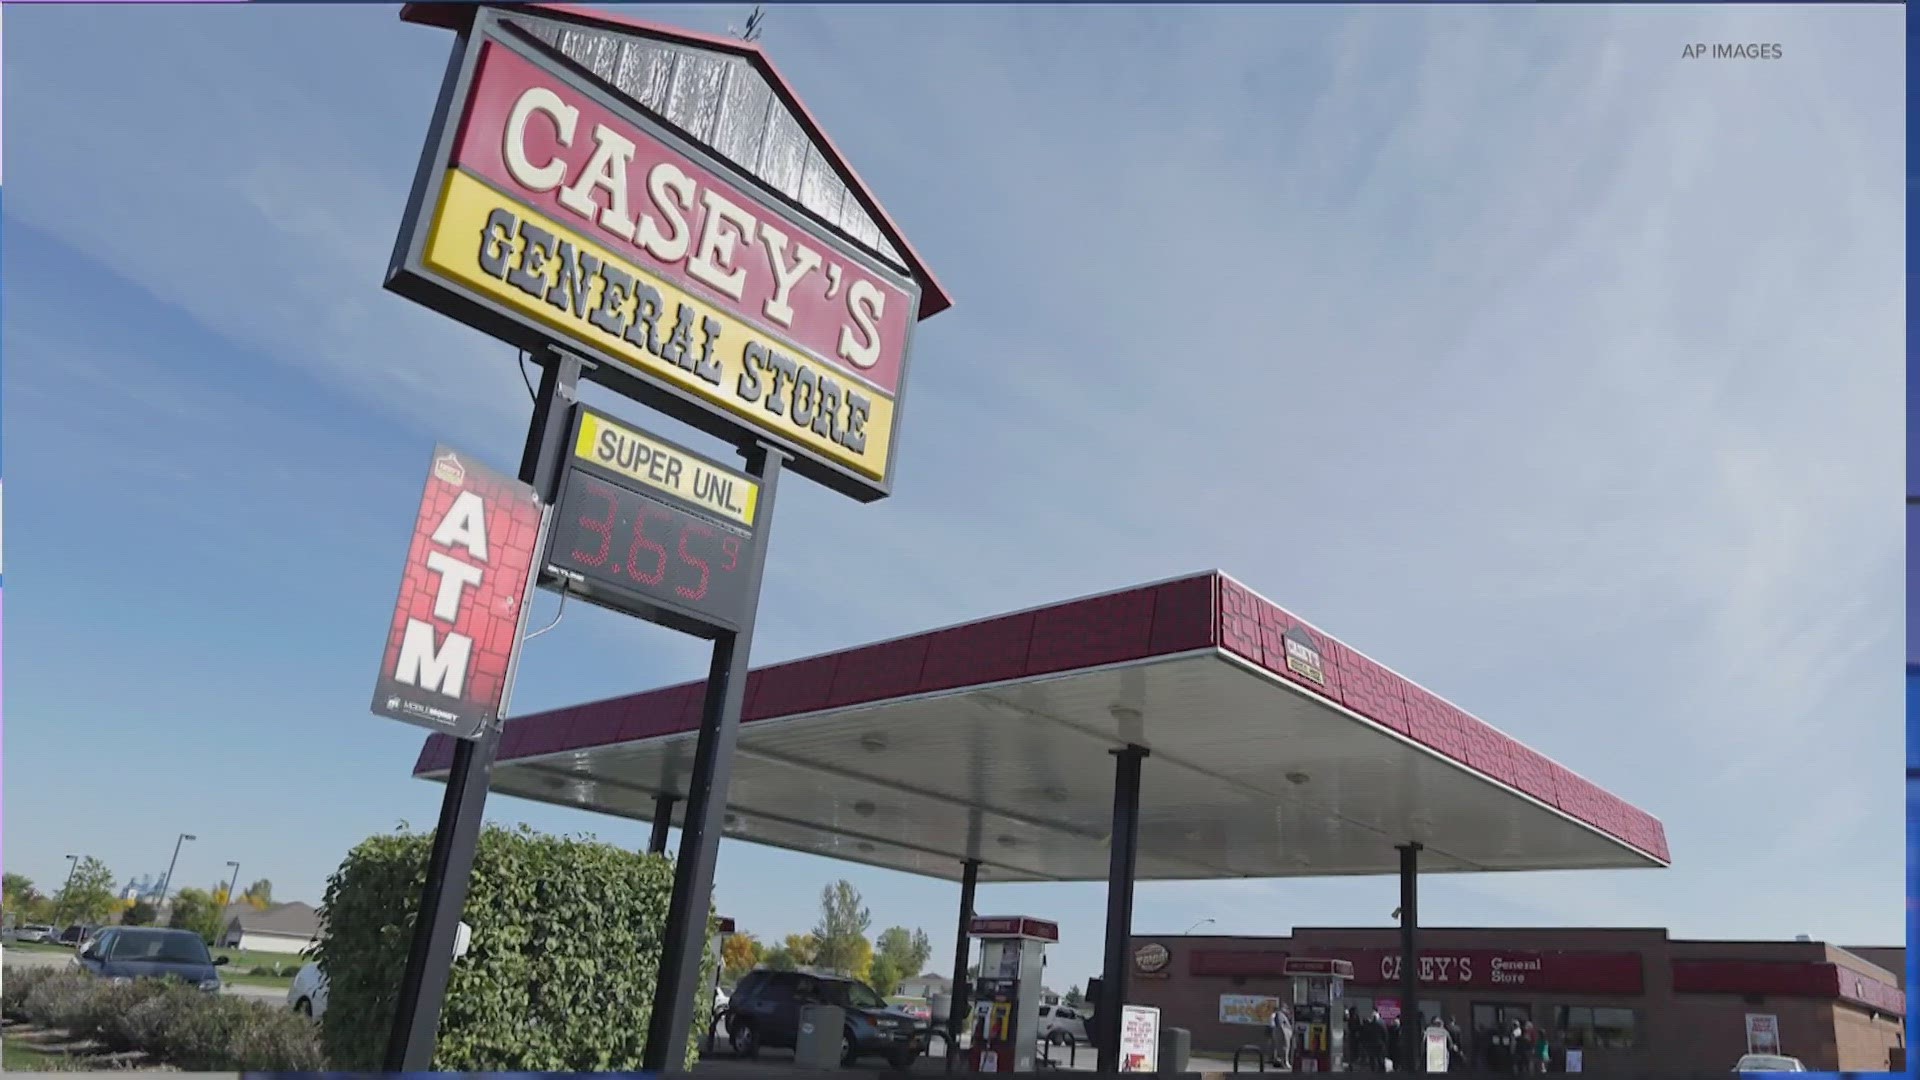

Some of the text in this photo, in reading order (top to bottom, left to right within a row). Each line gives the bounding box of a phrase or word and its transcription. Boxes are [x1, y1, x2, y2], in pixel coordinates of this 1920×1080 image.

[503, 87, 885, 369] CASEY'S
[477, 208, 871, 456] GENERAL STORE
[597, 429, 742, 513] SUPER UNL.
[395, 490, 488, 699] ATM
[1381, 955, 1472, 981] CAEY'S
[1491, 957, 1541, 970] General
[1491, 970, 1525, 983] Store
